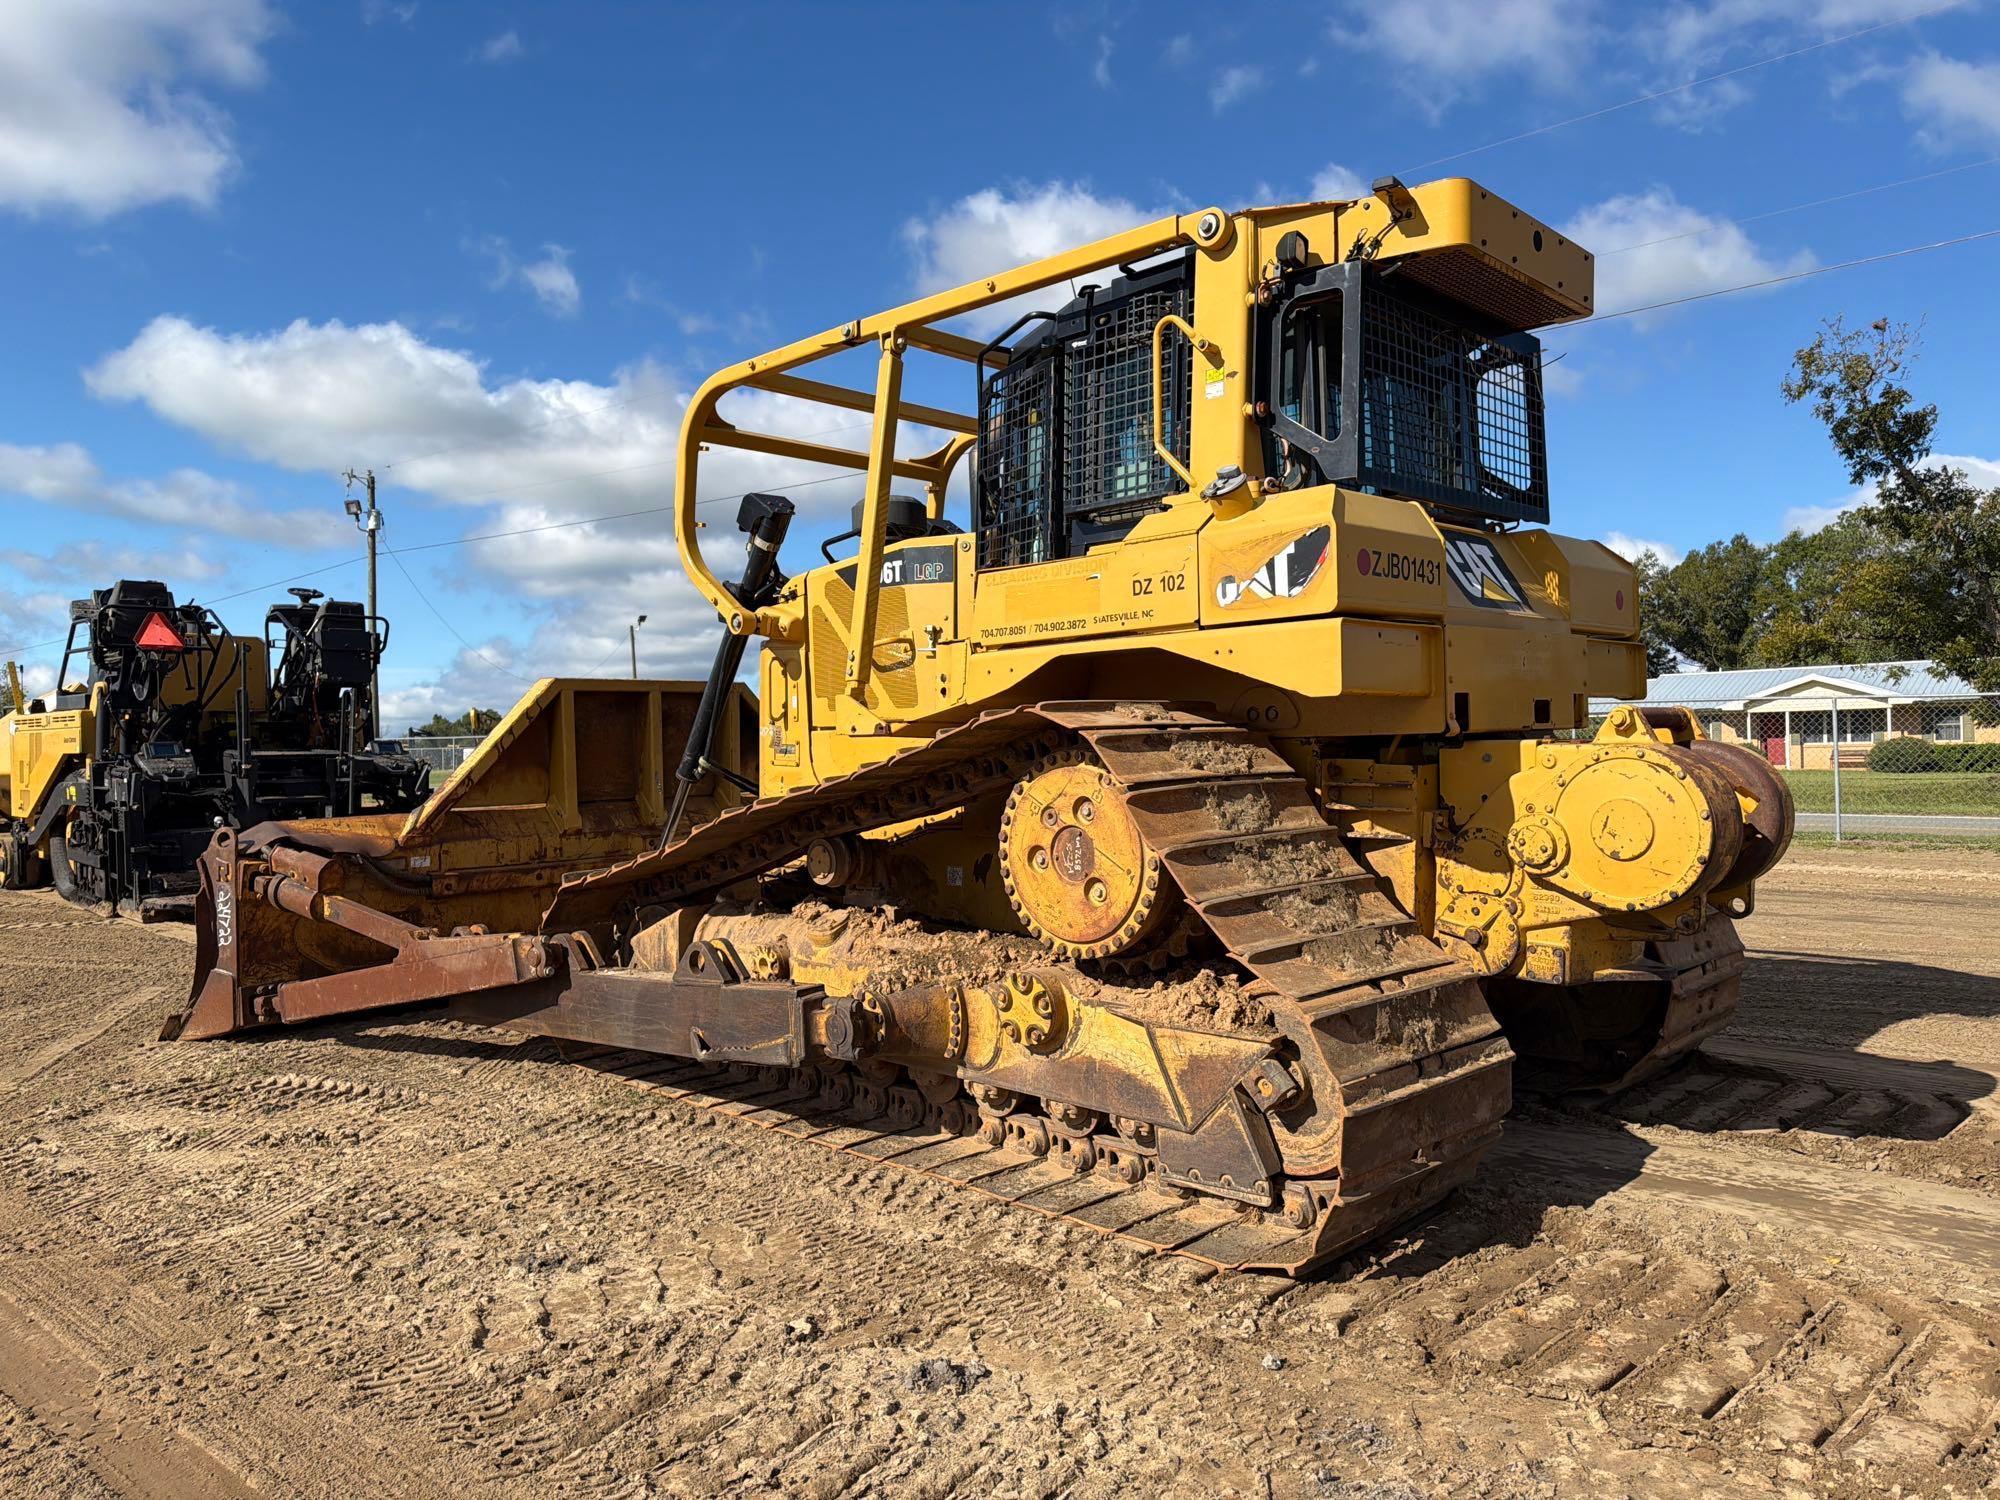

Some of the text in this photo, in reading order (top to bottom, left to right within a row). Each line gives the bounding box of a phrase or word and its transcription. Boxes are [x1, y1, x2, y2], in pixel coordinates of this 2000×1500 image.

[914, 562, 944, 580] LGP
[1371, 550, 1441, 586] ZJB01431
[1446, 540, 1524, 604] CAT
[1132, 574, 1185, 597] DZ 102
[1142, 608, 1154, 619] NC
[980, 625, 1027, 639] 704.707.8051
[1034, 619, 1087, 633] 704.902.3872
